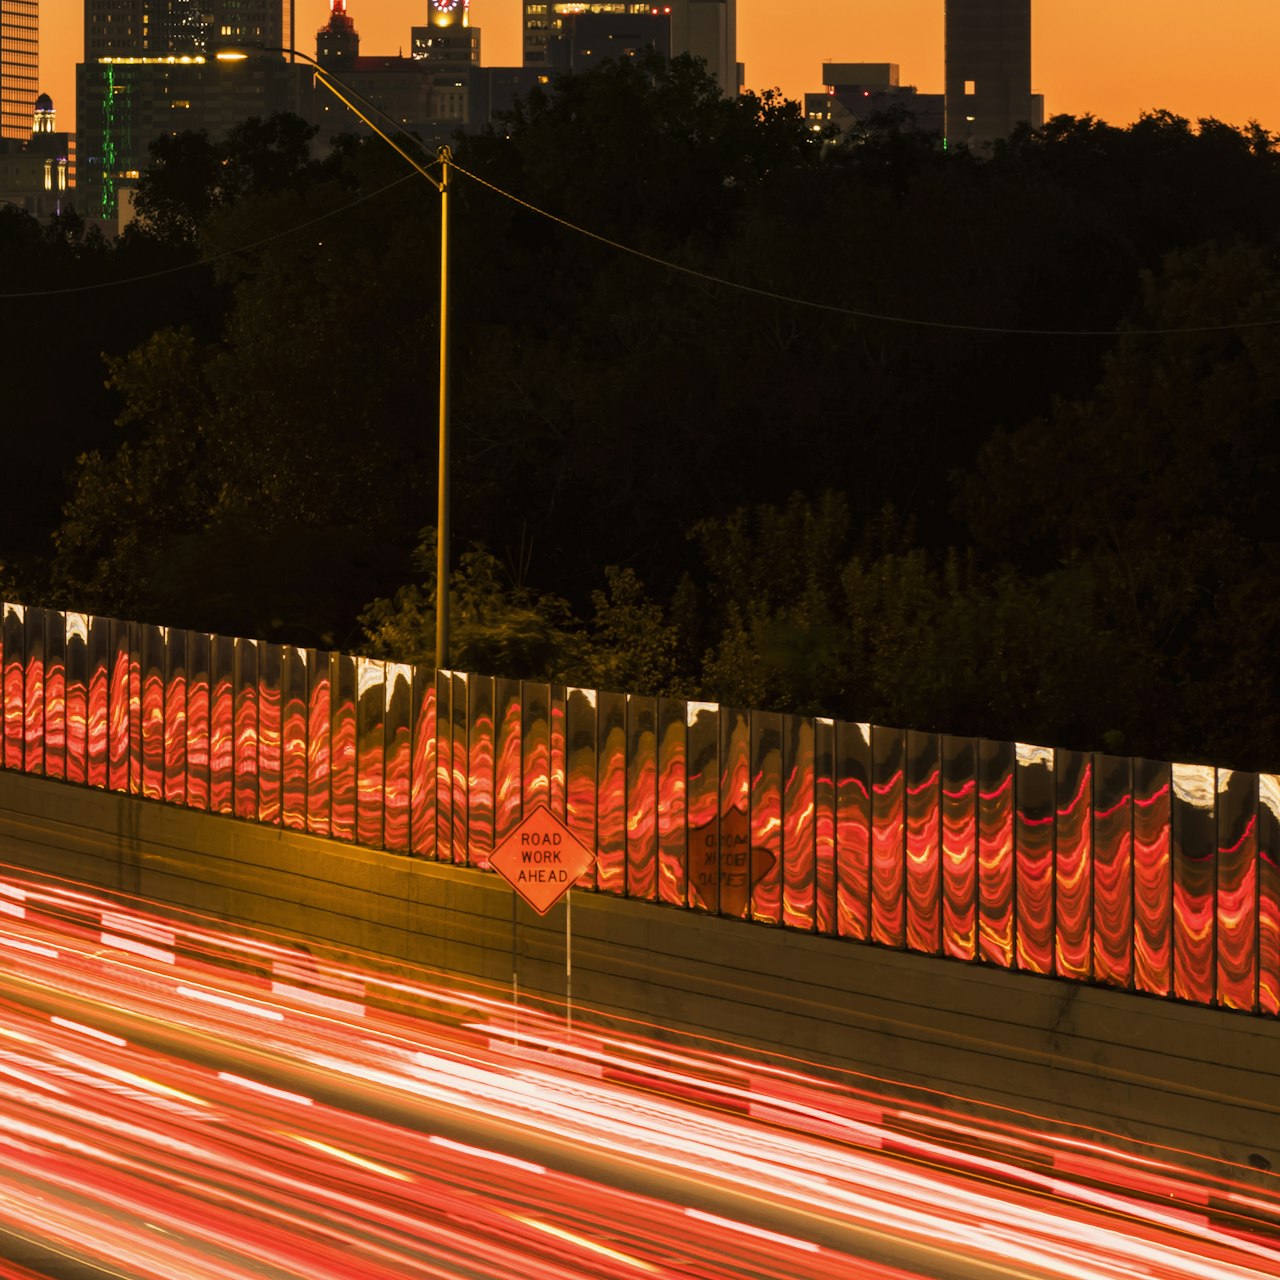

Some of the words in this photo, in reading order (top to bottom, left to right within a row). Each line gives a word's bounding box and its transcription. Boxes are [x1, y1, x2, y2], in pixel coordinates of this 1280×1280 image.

[521, 832, 562, 846] ROAD
[521, 851, 562, 864] WORK
[517, 870, 568, 883] AHEAD
